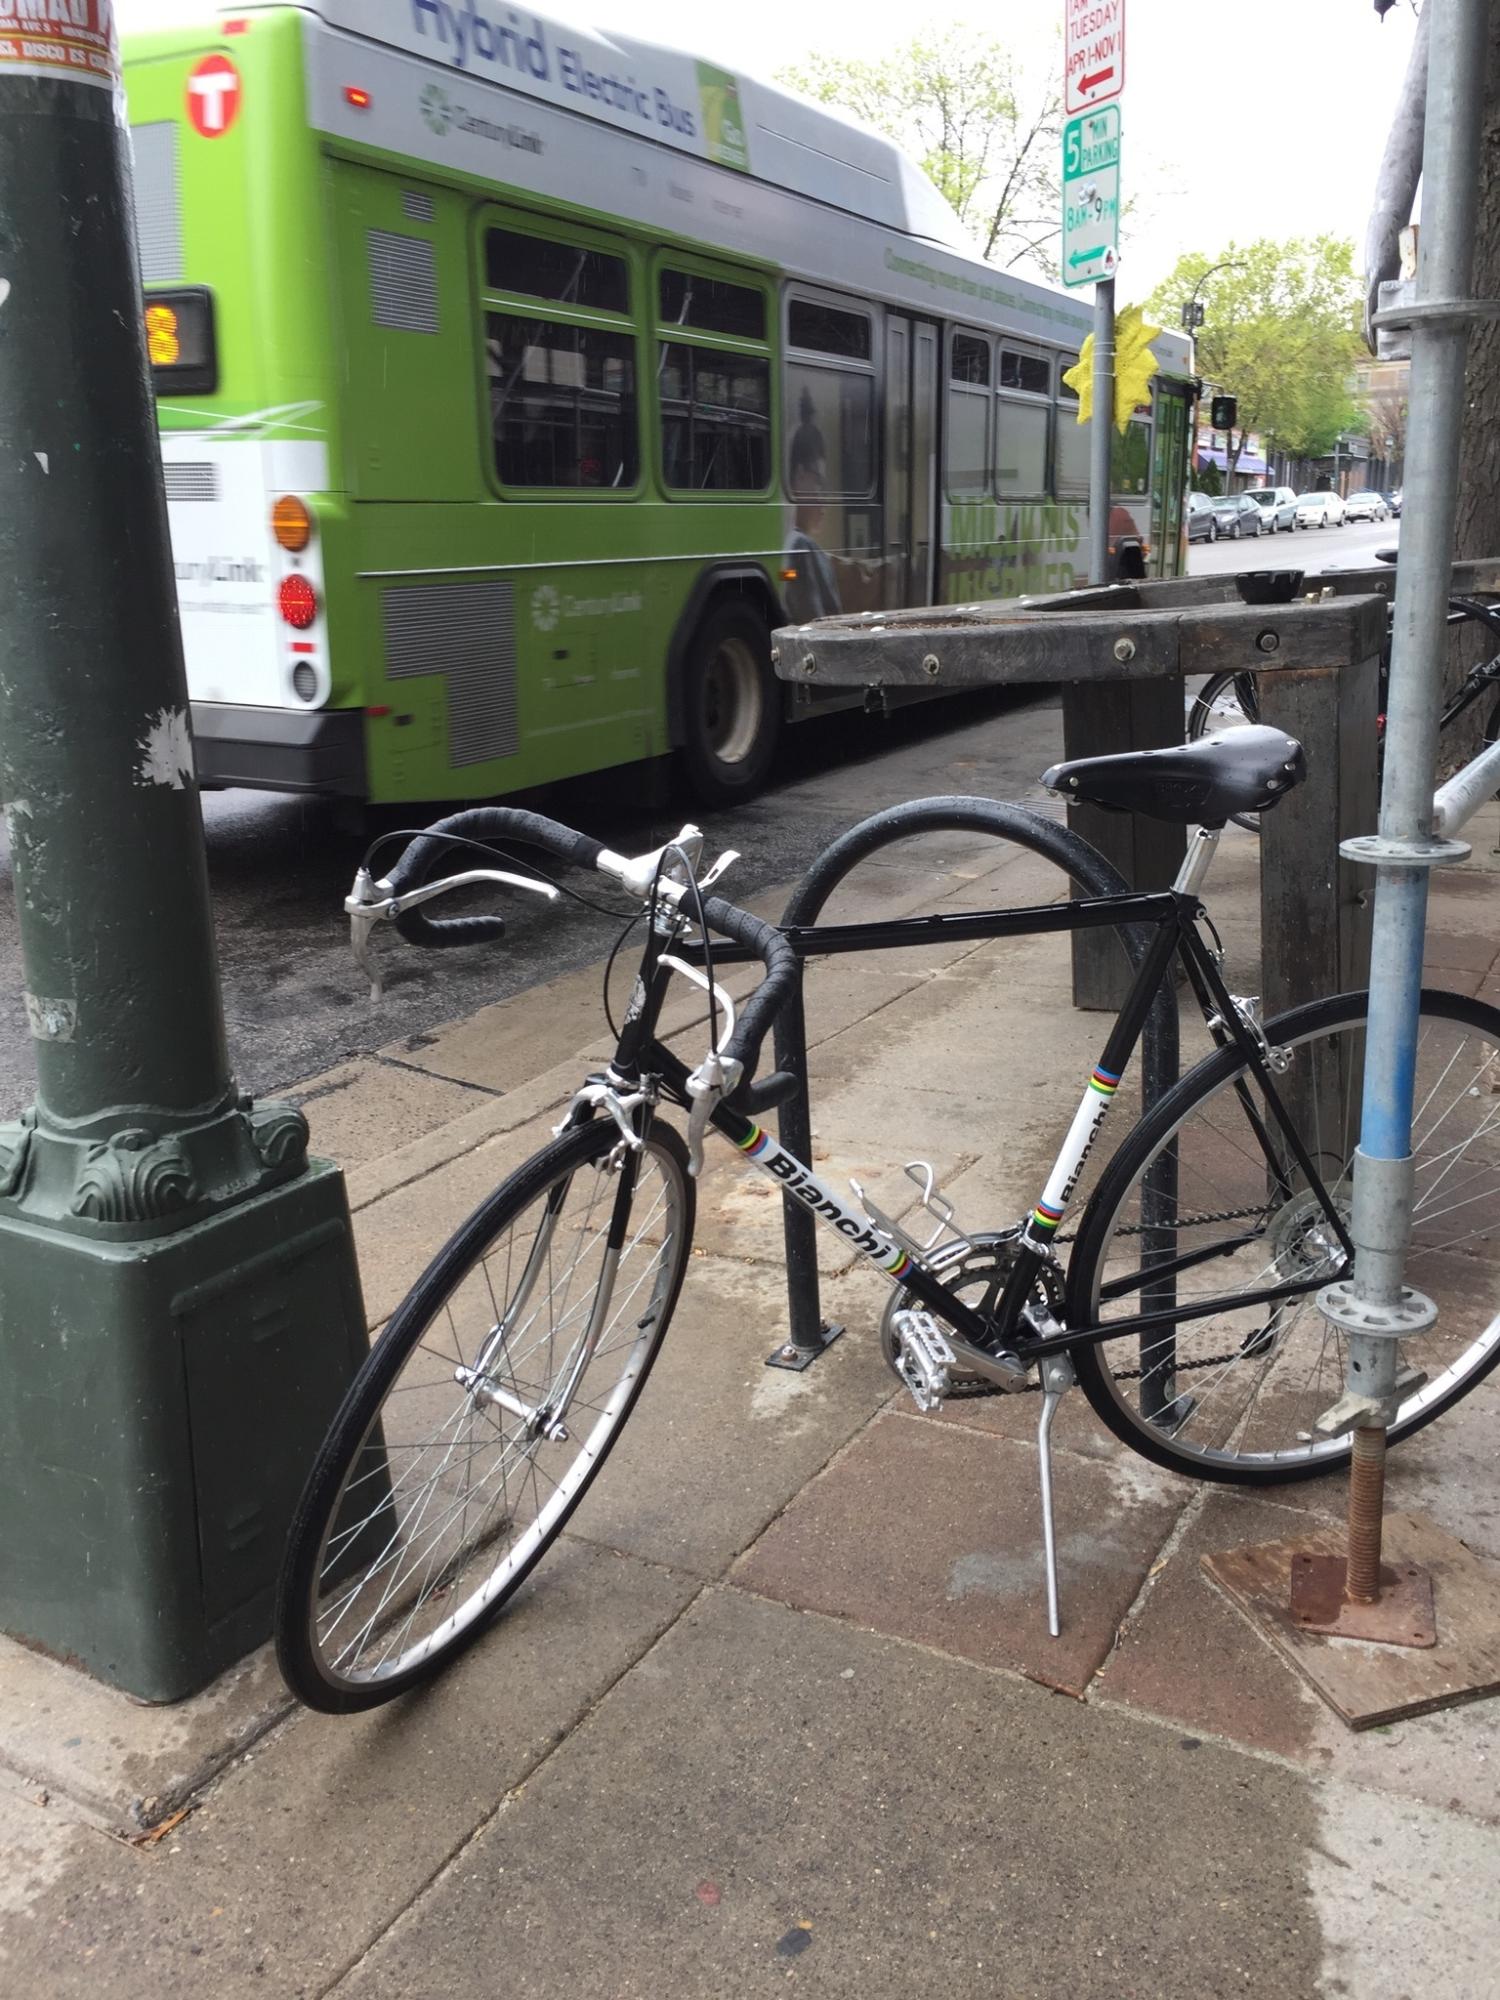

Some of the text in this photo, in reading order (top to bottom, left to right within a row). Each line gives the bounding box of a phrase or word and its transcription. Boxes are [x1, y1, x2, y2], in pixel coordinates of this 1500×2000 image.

[1070, 0, 1119, 42] TUESDAY
[556, 46, 651, 120] Electric
[653, 86, 697, 138] Bus
[1066, 49, 1086, 78] APR
[1067, 129, 1081, 174] 5
[1059, 1101, 1110, 1203] Bianchi
[764, 1151, 892, 1260] Bianchi
